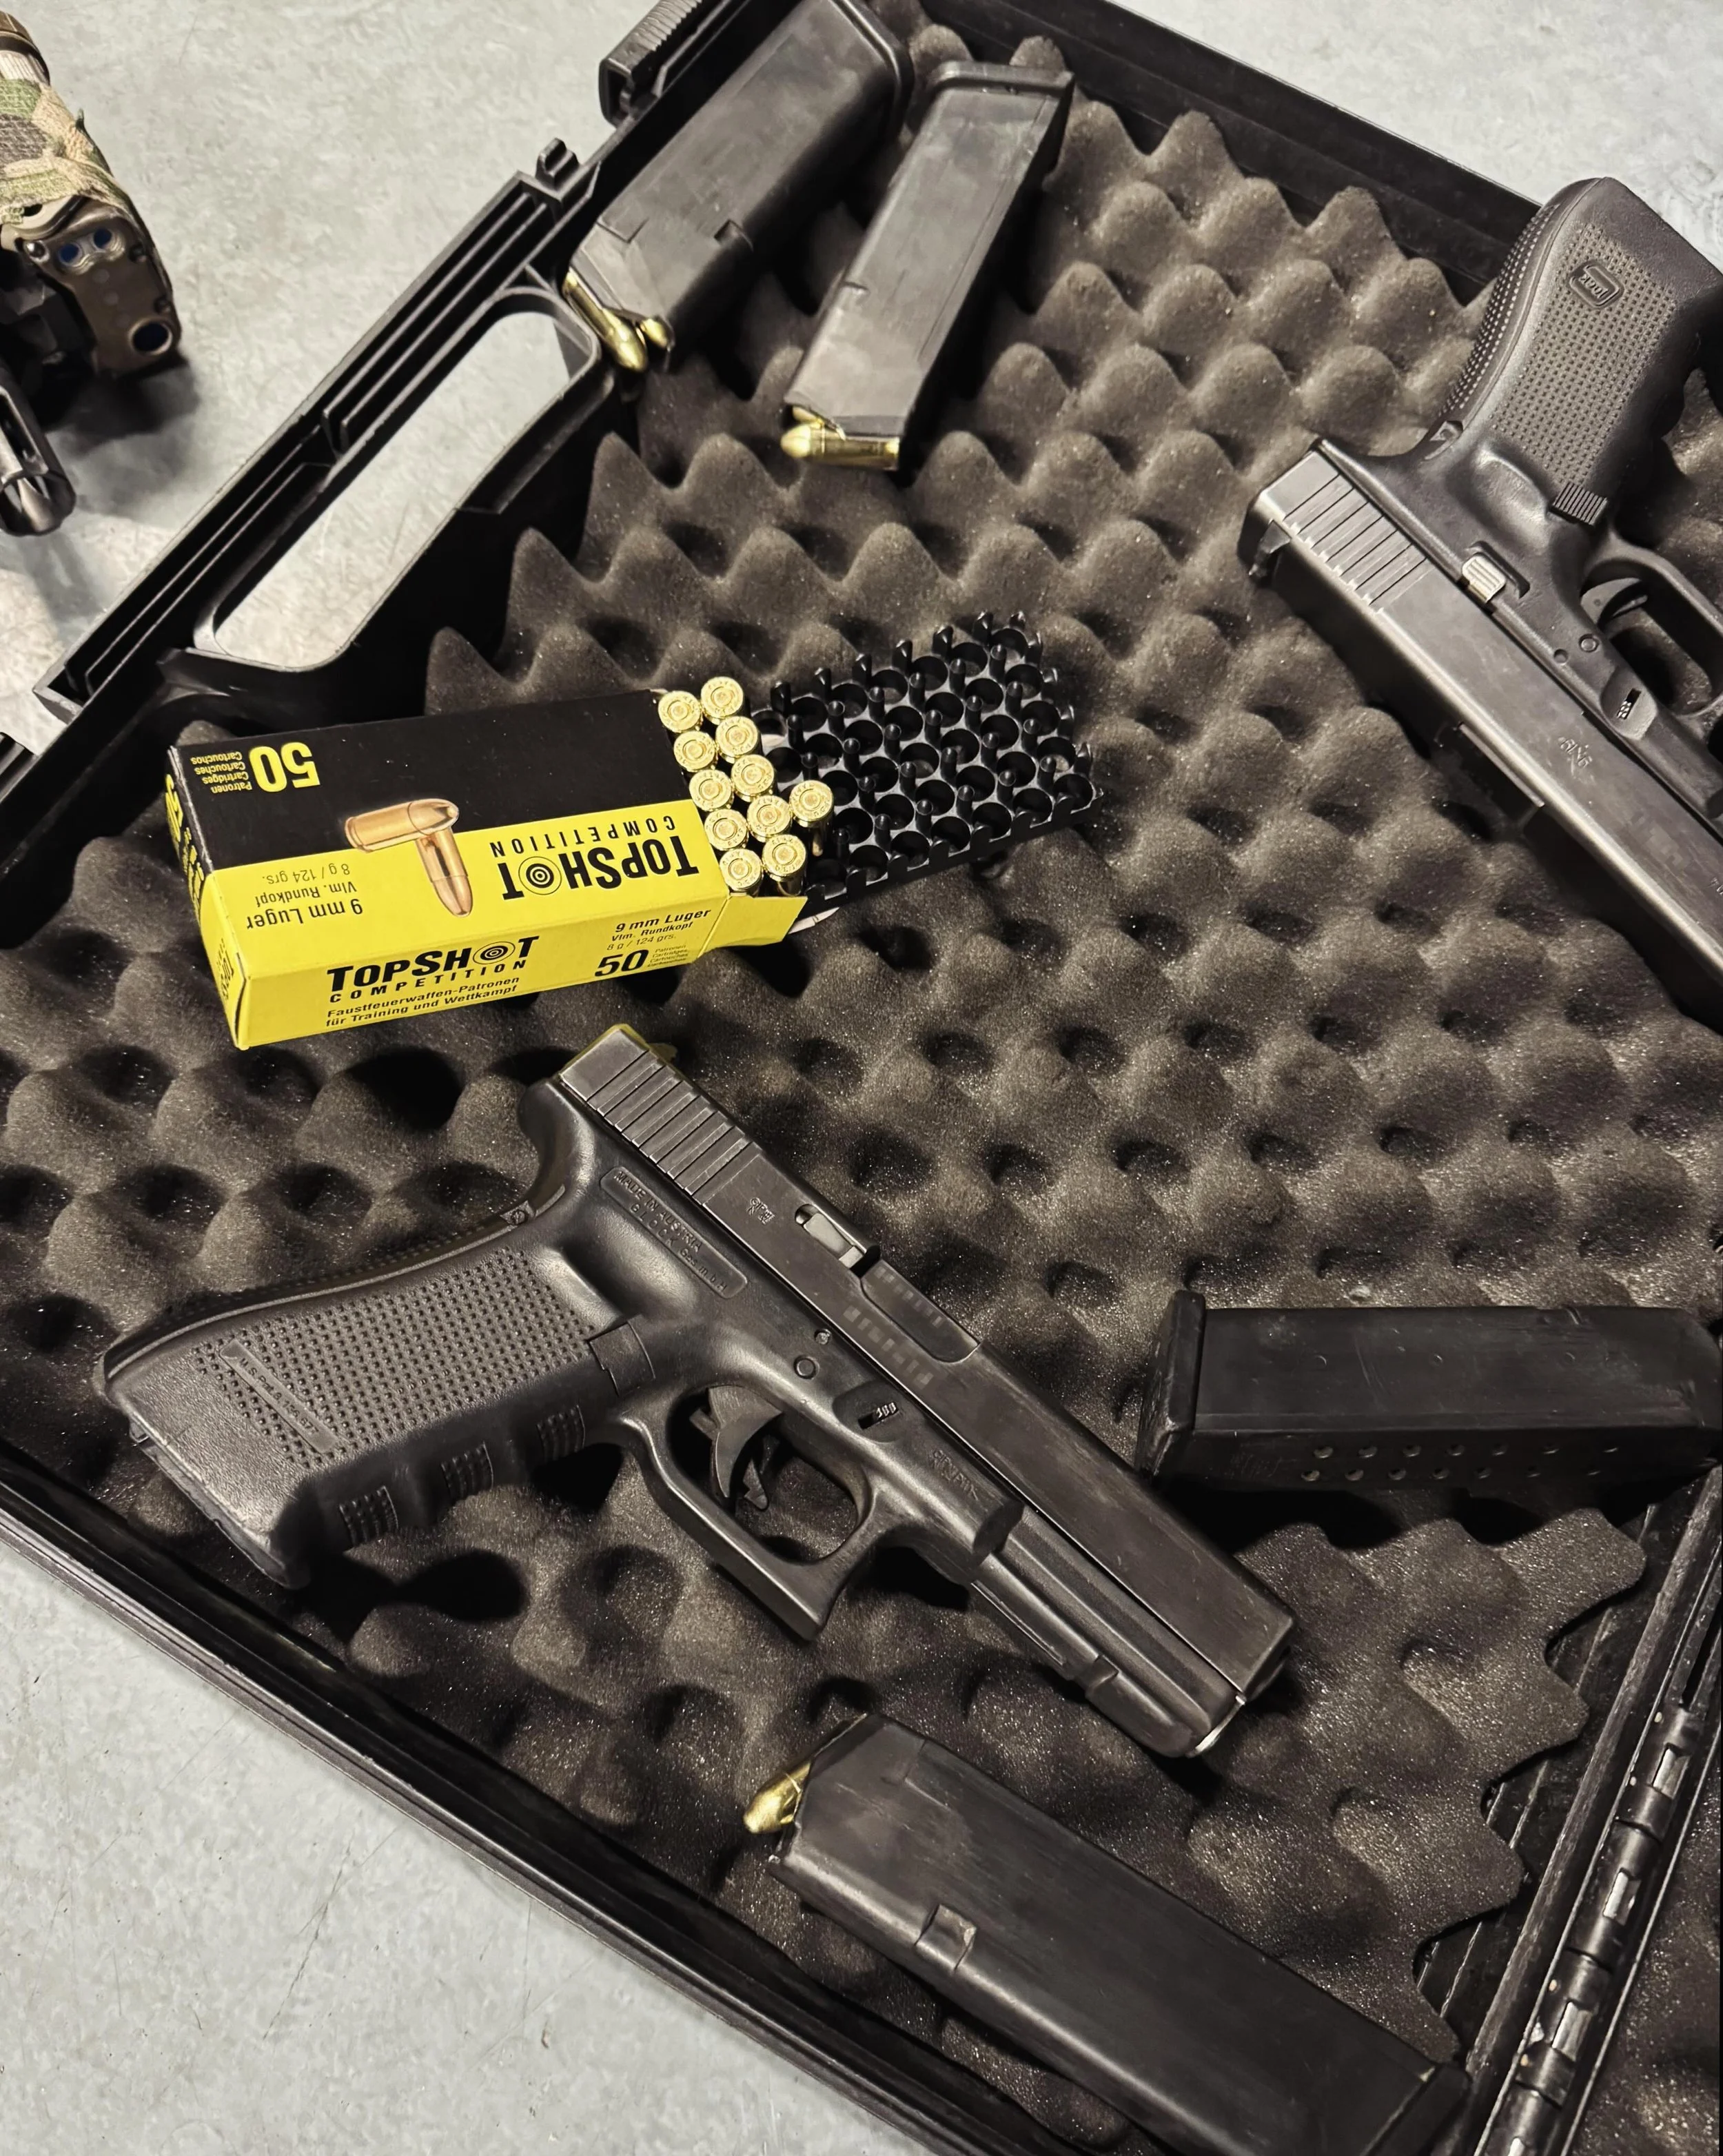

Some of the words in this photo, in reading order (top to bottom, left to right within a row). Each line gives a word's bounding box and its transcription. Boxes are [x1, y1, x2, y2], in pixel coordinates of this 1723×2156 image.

[190, 751, 243, 765] Cartouchos
[194, 762, 245, 775] Cartouches
[249, 742, 320, 793] 50
[202, 771, 249, 784] Cartridges
[210, 781, 252, 794] Patronen
[489, 815, 676, 857] COMPETITION
[263, 871, 288, 884] grs.
[293, 868, 317, 884] 124
[329, 863, 337, 875] g
[340, 864, 350, 875] 8
[324, 881, 357, 894] Vlm.
[255, 886, 320, 908] Rundkopf
[308, 901, 345, 918] mm
[350, 898, 363, 915] 9
[247, 908, 304, 930] Luger
[615, 923, 626, 933] 9
[629, 918, 660, 930] mm
[664, 910, 711, 924] Luger
[611, 933, 636, 942] Vlm.
[640, 922, 694, 937] Rundkopf
[636, 935, 654, 946] 124
[656, 933, 677, 943] grs.
[595, 948, 649, 977] 50
[329, 959, 527, 1004] COMPETITION
[325, 1017, 347, 1027] für
[351, 1006, 409, 1022] Training
[414, 999, 439, 1011] und
[445, 985, 518, 1005] Wettkampf
[327, 977, 520, 1018] Faustfeuerwaffen-Patronen
[613, 1171, 646, 1201] MADE
[645, 1199, 660, 1212] IN
[656, 1210, 703, 1253] AUSTRIA
[630, 1203, 677, 1248] GLOCK
